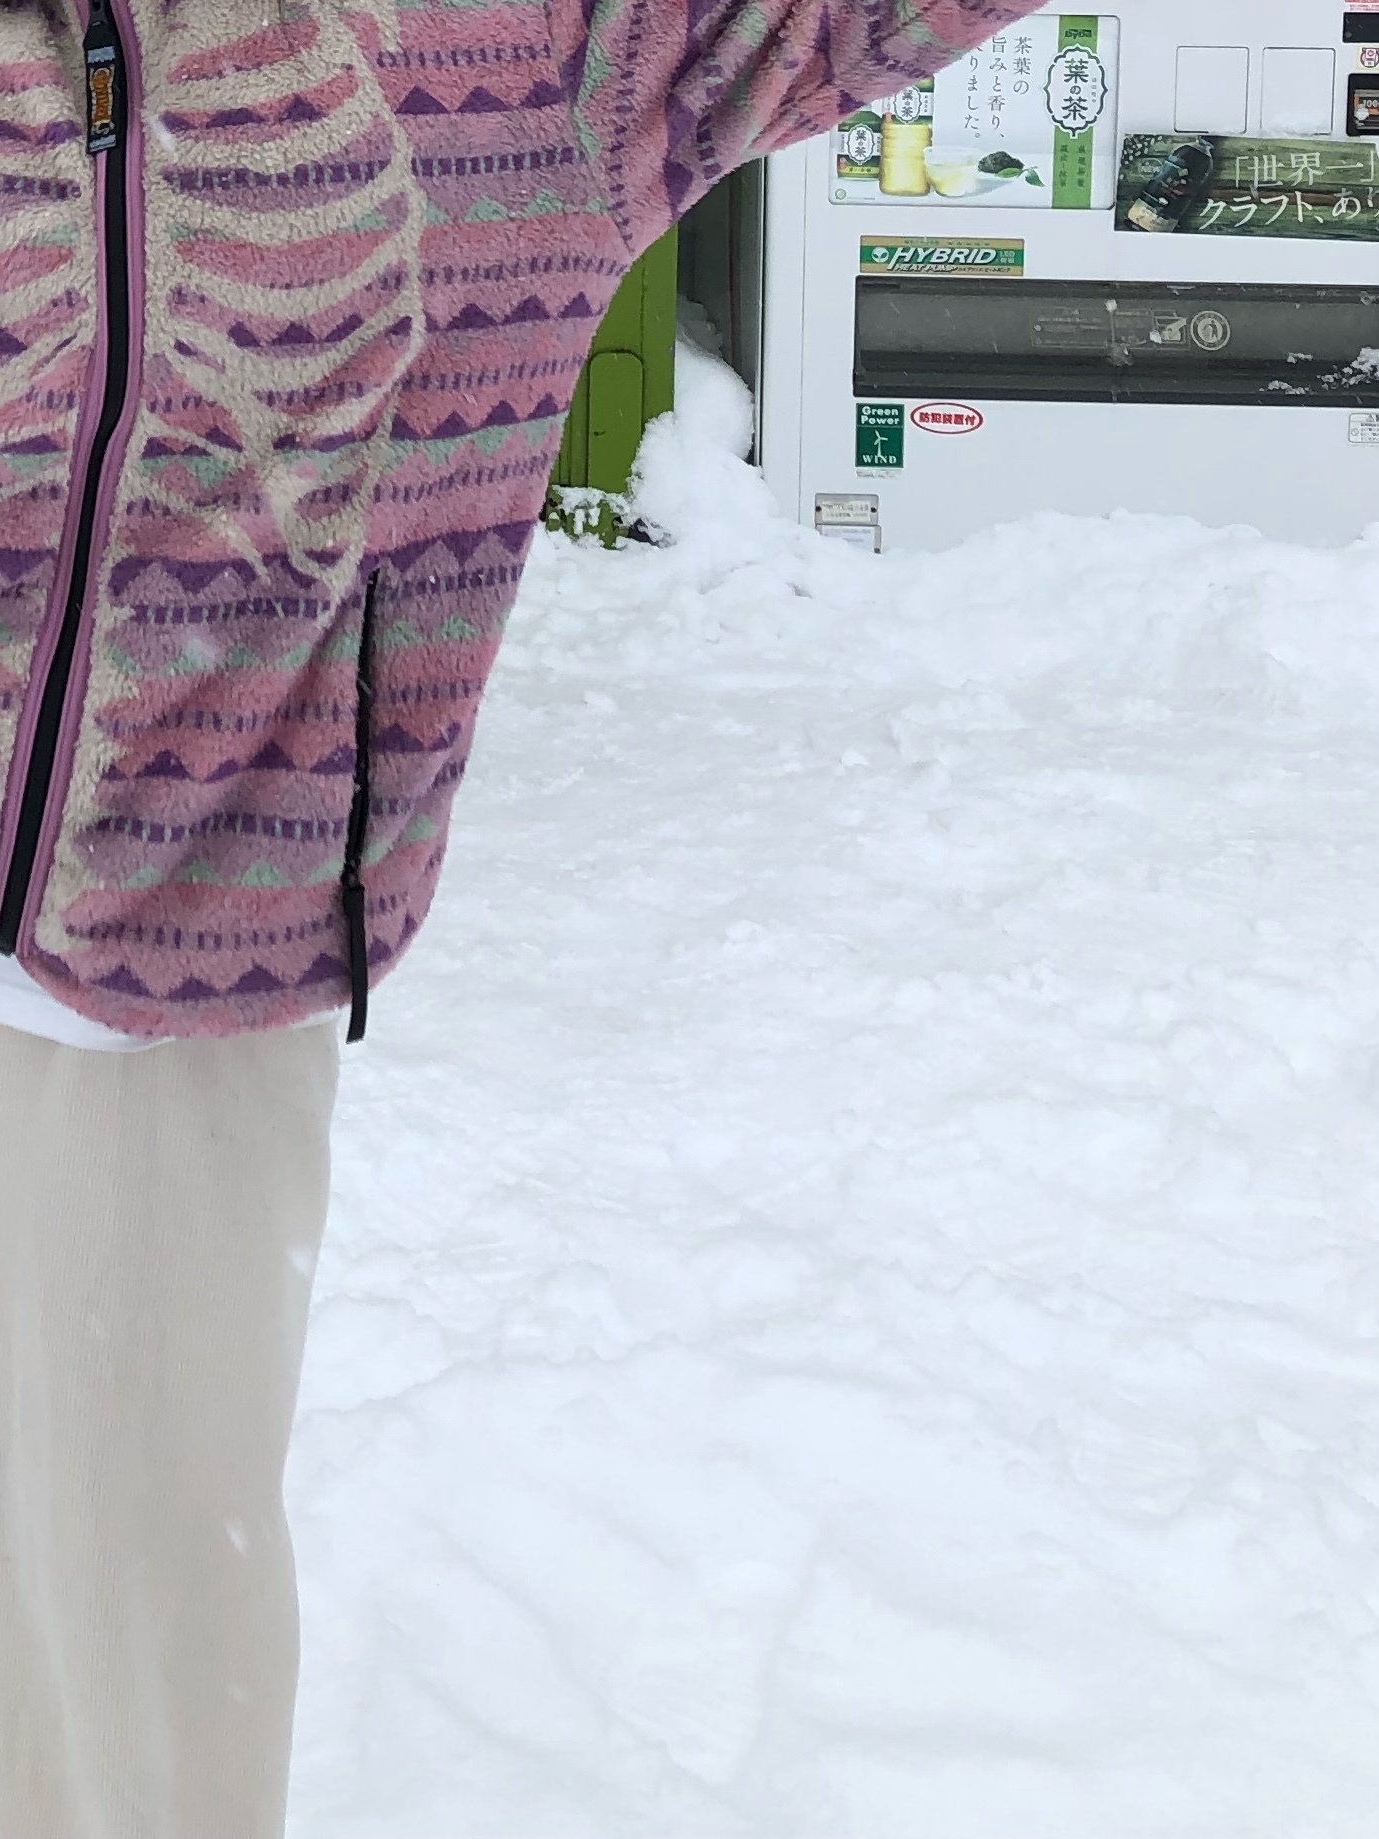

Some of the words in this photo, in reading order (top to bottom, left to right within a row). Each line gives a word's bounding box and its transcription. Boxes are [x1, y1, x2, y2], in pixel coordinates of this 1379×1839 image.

[1013, 36, 1033, 95] 茶葉の
[1062, 58, 1089, 120] 葉の茶
[888, 248, 997, 268] HYBRID
[862, 406, 898, 416] Green
[861, 416, 900, 425] Power
[862, 455, 897, 464] WIND
